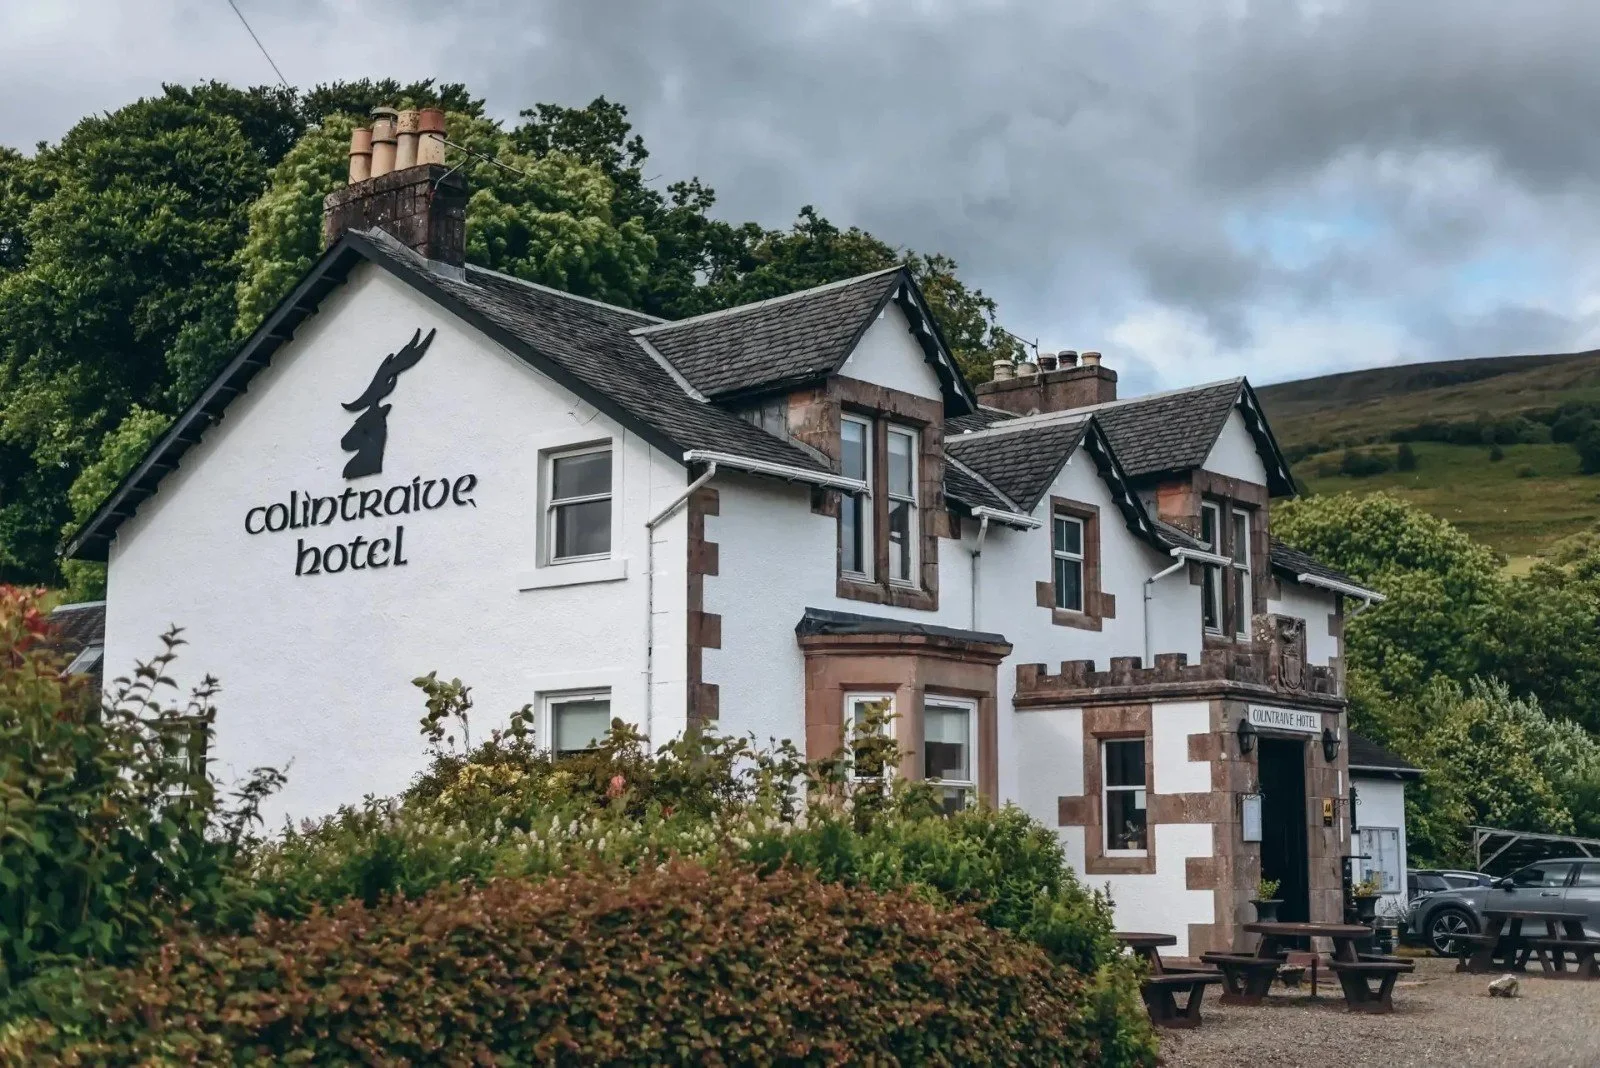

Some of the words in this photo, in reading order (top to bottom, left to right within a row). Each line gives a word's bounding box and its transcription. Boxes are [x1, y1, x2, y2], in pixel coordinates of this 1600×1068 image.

[295, 525, 408, 576] hotel
[1253, 709, 1293, 726] COLINTRAIVE
[1297, 714, 1317, 728] HOTEL
